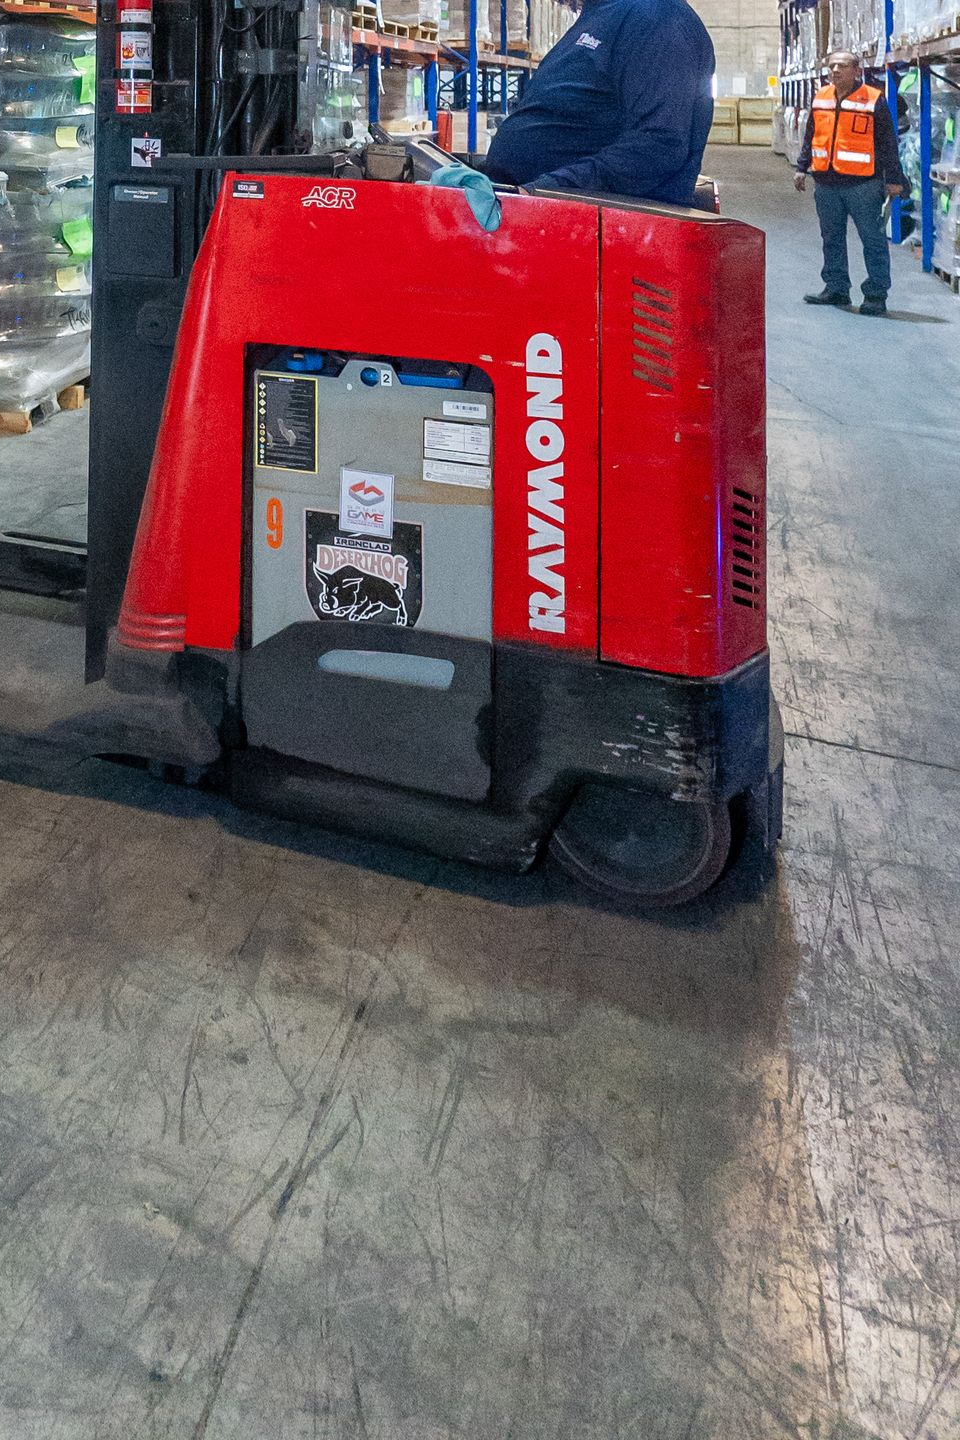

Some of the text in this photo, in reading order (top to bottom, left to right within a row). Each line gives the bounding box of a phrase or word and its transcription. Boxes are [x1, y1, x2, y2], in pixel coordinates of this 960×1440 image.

[300, 185, 356, 210] ACR
[382, 373, 391, 384] 2
[524, 332, 566, 634] RAYMOND
[266, 496, 284, 550] 9
[347, 509, 384, 523] GAME
[335, 537, 390, 551] IRONCLAD
[318, 546, 407, 584] DESERTHOG
